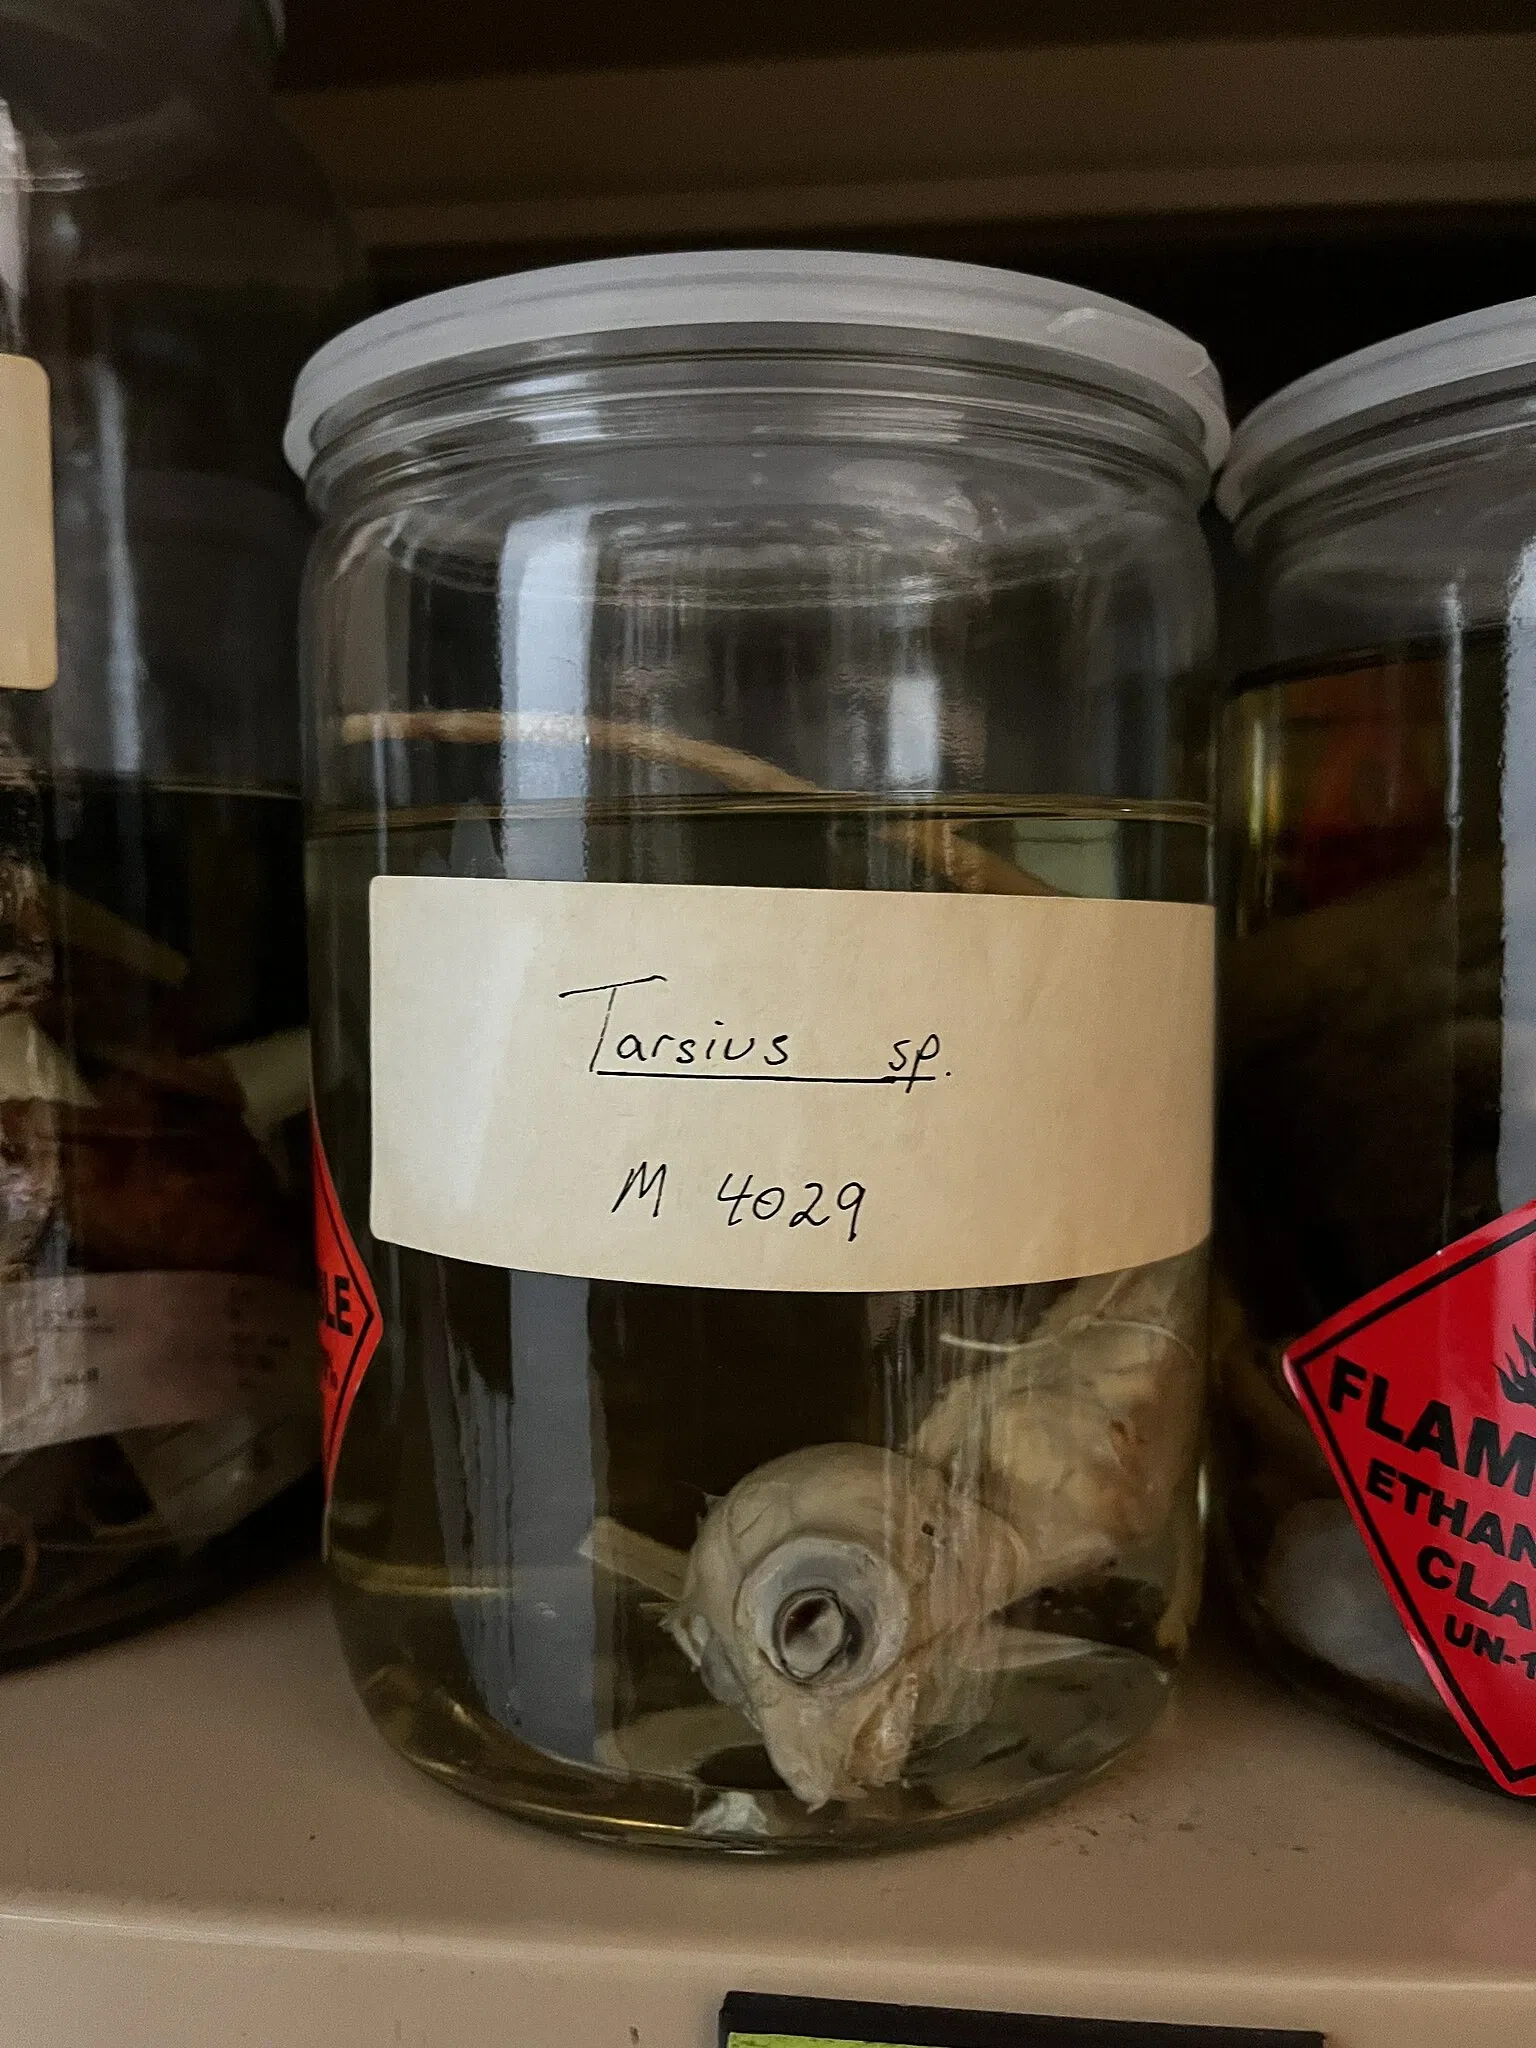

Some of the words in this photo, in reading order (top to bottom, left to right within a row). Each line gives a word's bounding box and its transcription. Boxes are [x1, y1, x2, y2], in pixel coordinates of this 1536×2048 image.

[558, 974, 789, 1073] Tarsius
[887, 1032, 953, 1094] sp.
[610, 1160, 668, 1218] M
[716, 1172, 867, 1243] 4029
[1326, 1354, 1536, 1498] FLAM
[1415, 1543, 1535, 1631] CLA
